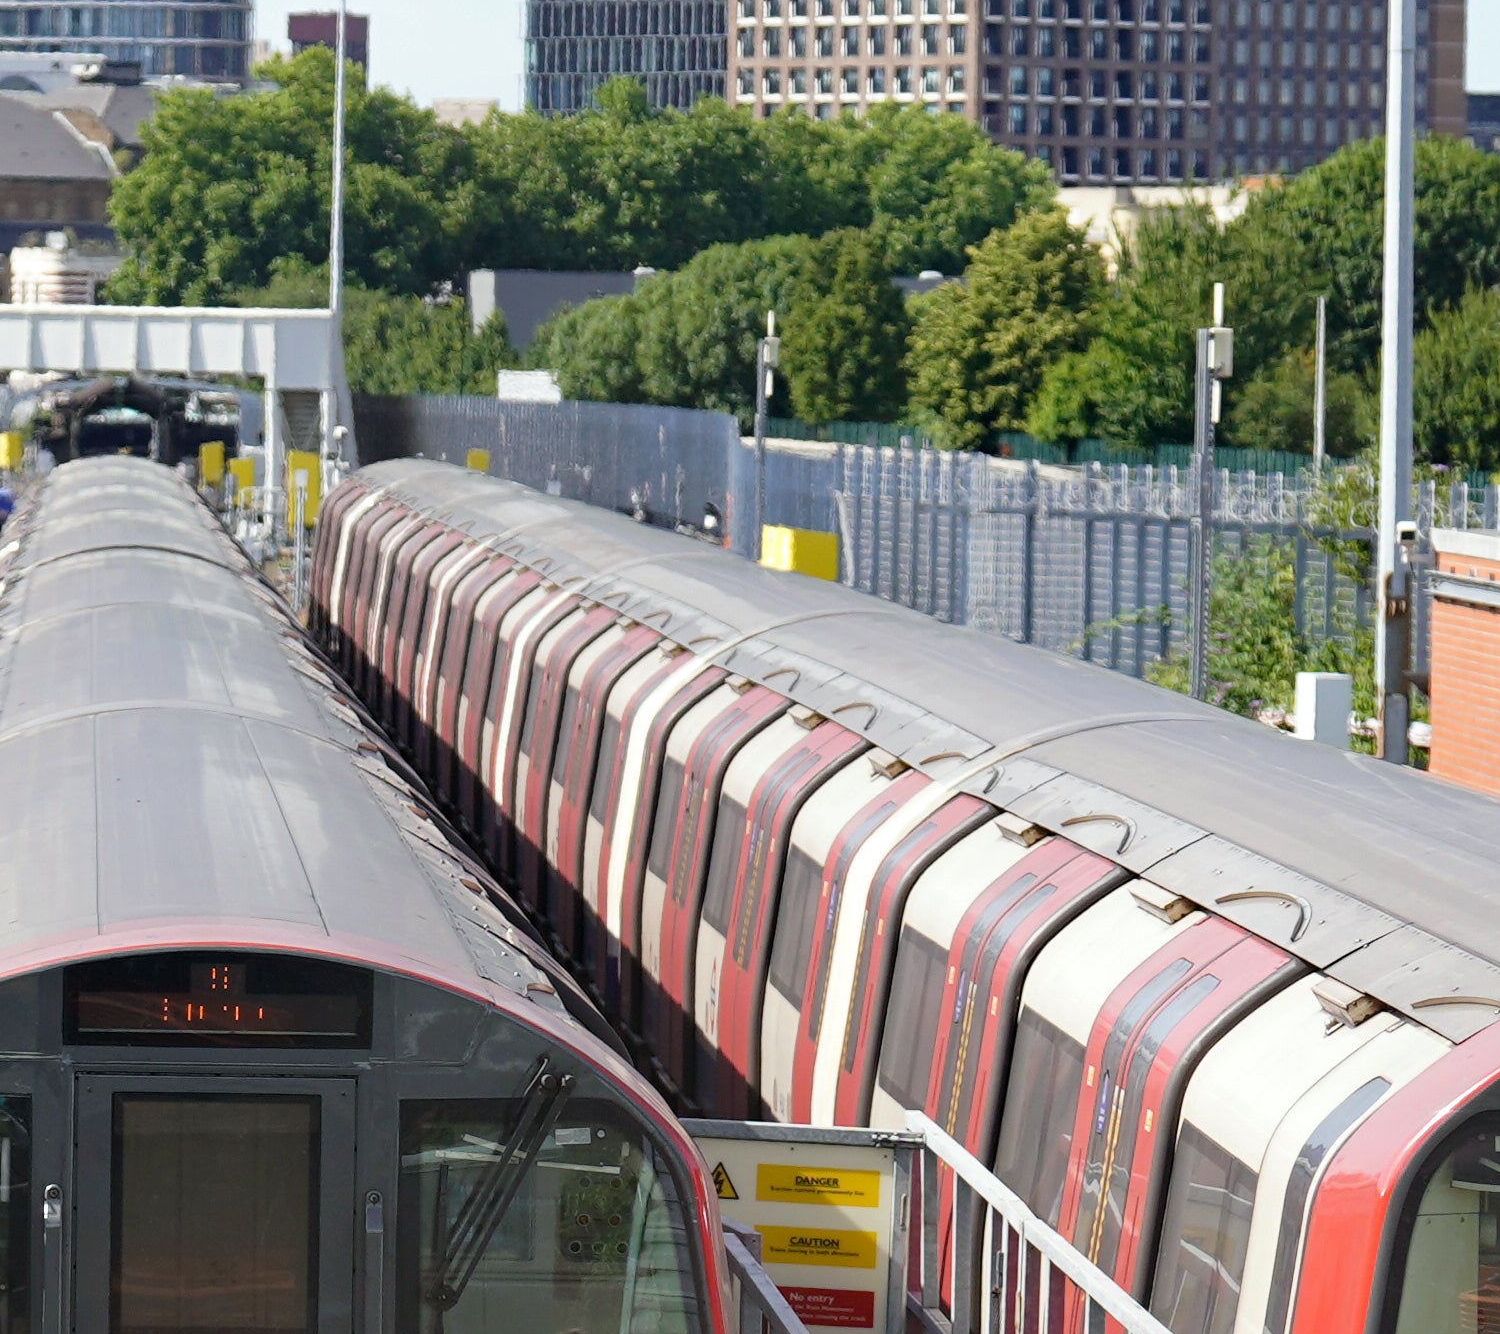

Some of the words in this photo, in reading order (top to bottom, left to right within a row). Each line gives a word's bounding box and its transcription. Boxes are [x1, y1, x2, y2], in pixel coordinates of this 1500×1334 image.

[795, 1176, 839, 1187] DANGER
[789, 1236, 840, 1248] CAUTION
[789, 1292, 805, 1302] No
[807, 1294, 835, 1305] entry
